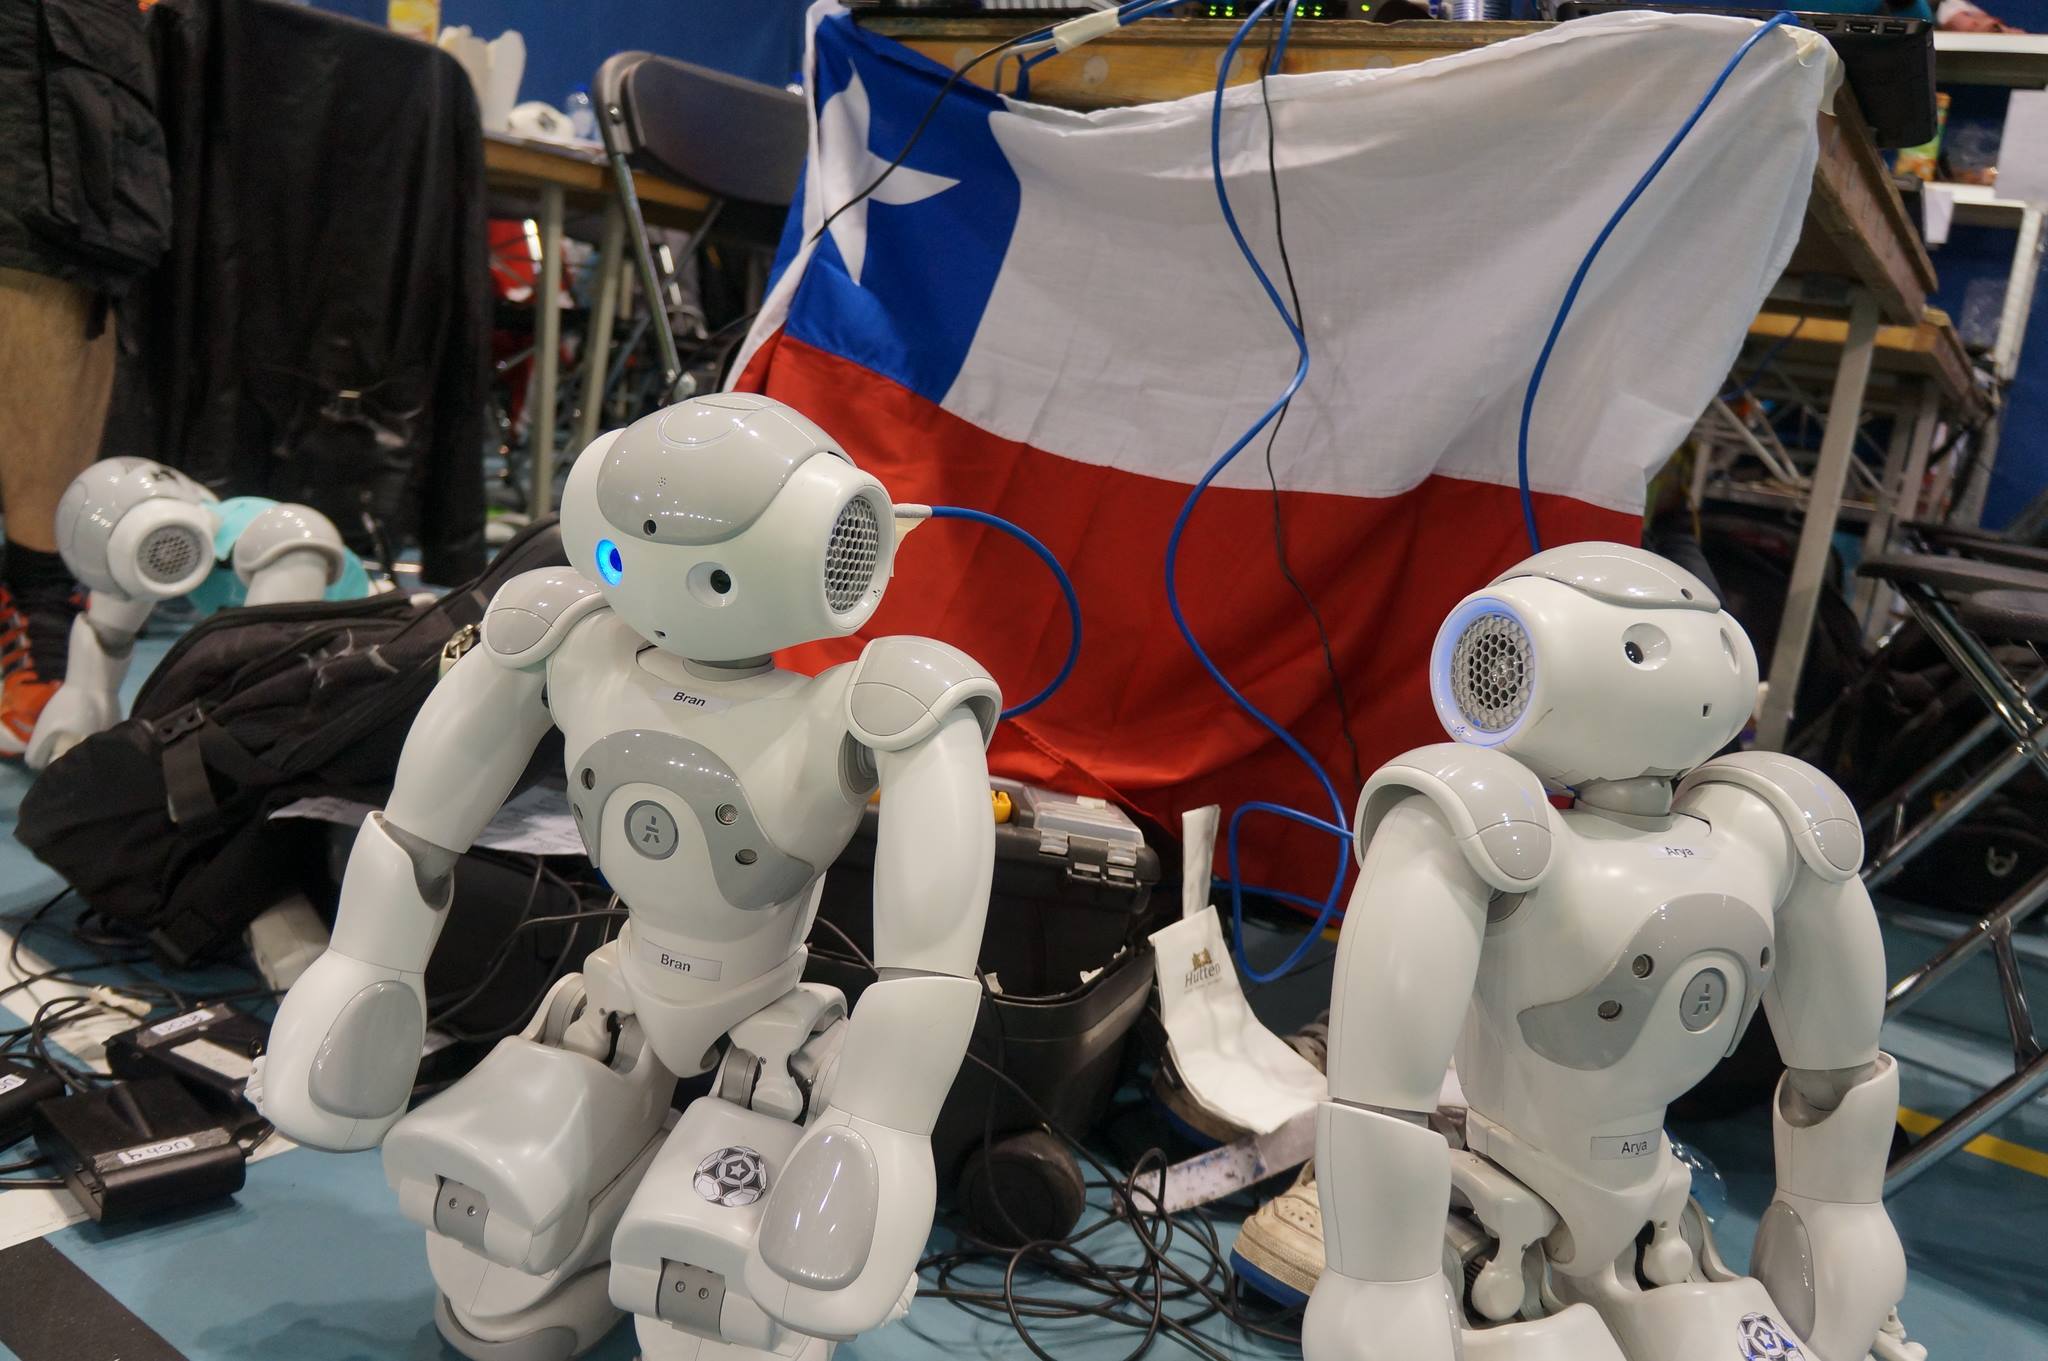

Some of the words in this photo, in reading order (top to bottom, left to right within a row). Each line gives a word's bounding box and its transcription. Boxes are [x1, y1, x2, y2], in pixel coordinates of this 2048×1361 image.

[672, 691, 706, 707] Bran
[1665, 846, 1694, 858] Arya
[660, 953, 691, 972] Bran
[1185, 962, 1221, 987] Hutten
[1621, 1140, 1648, 1155] Arya
